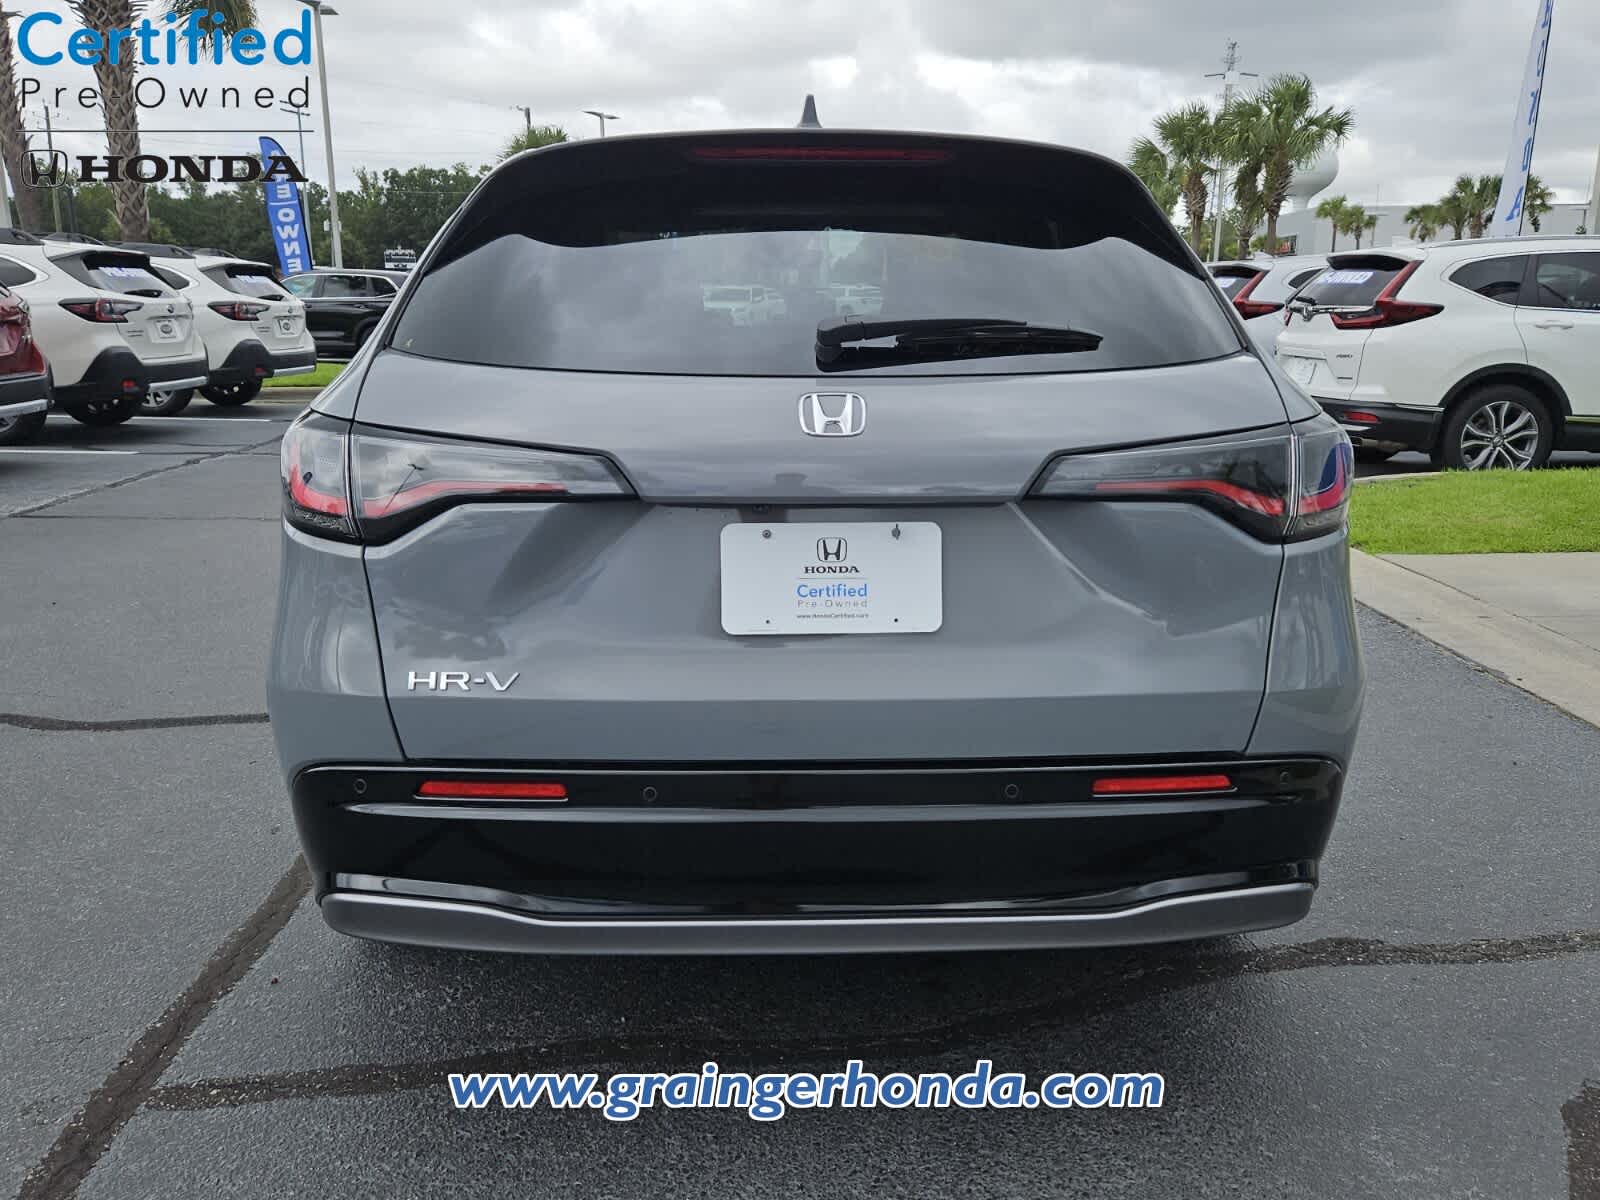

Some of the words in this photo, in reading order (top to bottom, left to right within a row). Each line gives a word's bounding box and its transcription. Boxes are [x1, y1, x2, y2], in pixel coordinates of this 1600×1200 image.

[803, 565, 861, 574] HONDA
[796, 583, 868, 598] Certified
[407, 671, 521, 691] HR-V
